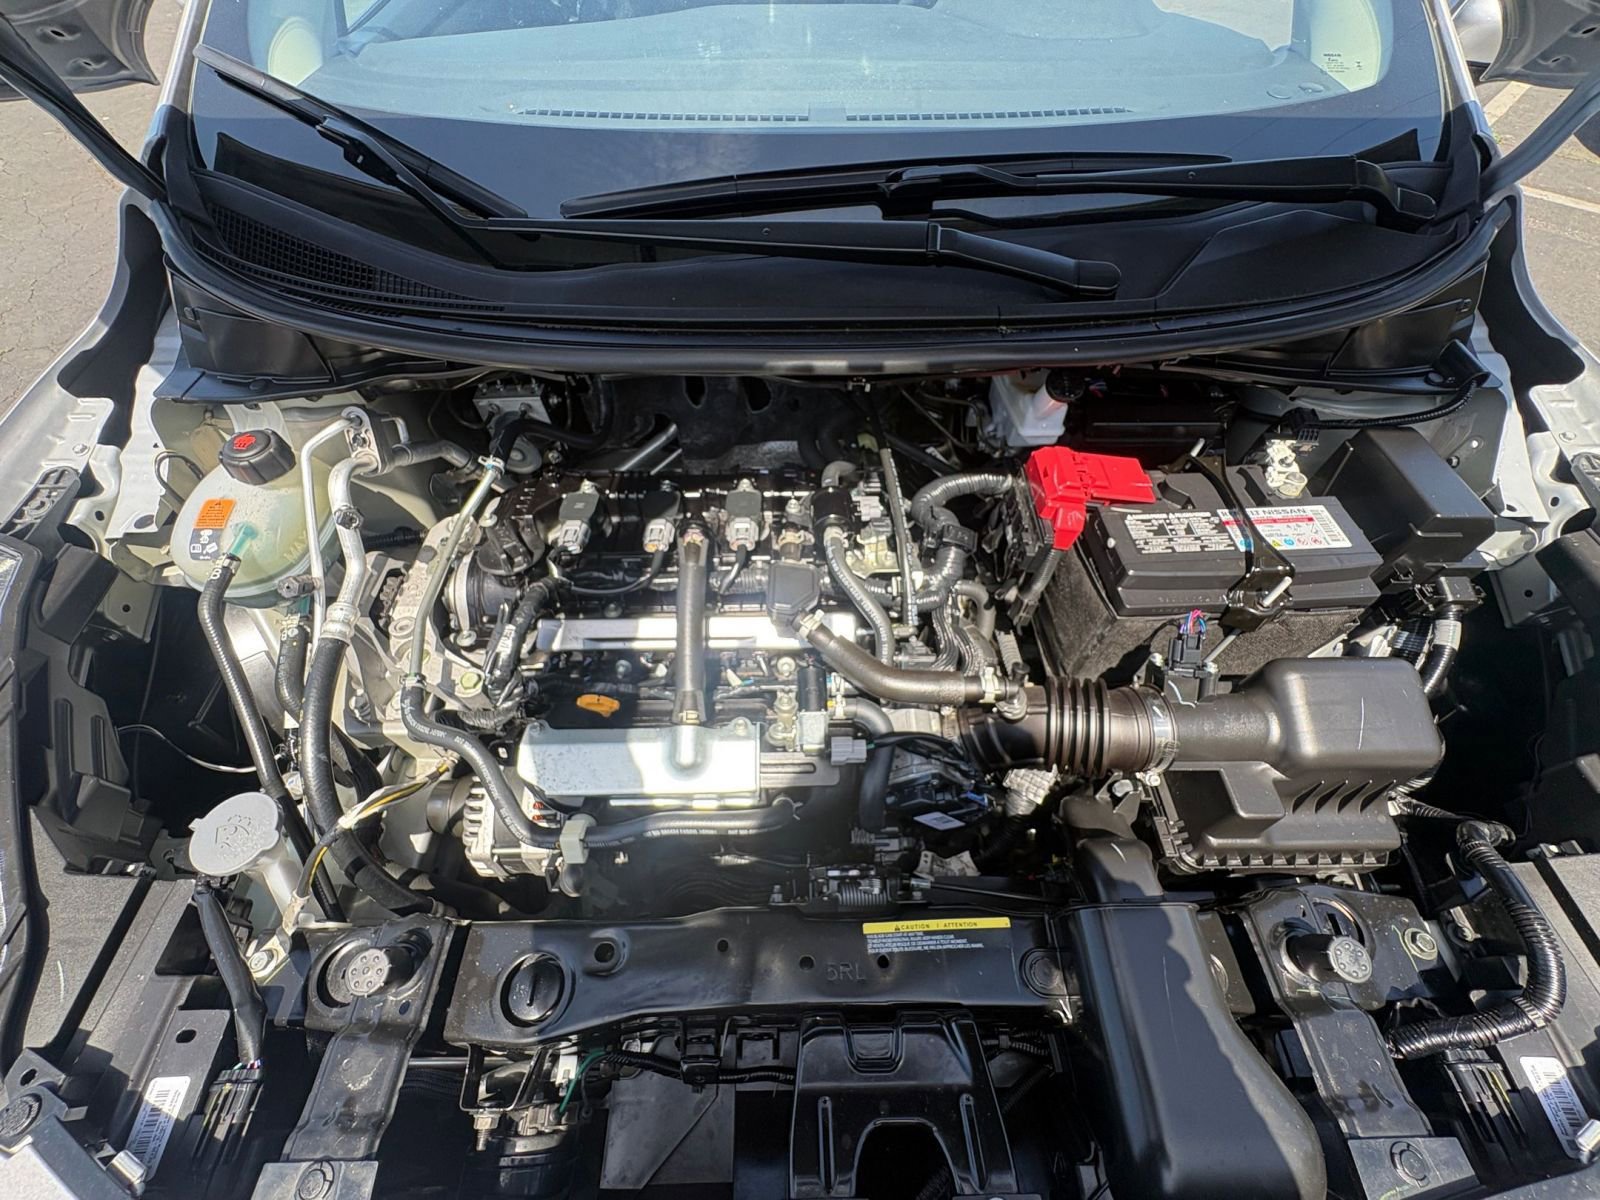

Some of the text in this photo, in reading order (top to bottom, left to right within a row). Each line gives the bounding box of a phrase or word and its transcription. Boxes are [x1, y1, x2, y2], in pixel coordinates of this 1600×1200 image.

[1262, 508, 1308, 516] NISSAN
[900, 923, 930, 931] CAUTION
[943, 921, 978, 929] ATTENTION
